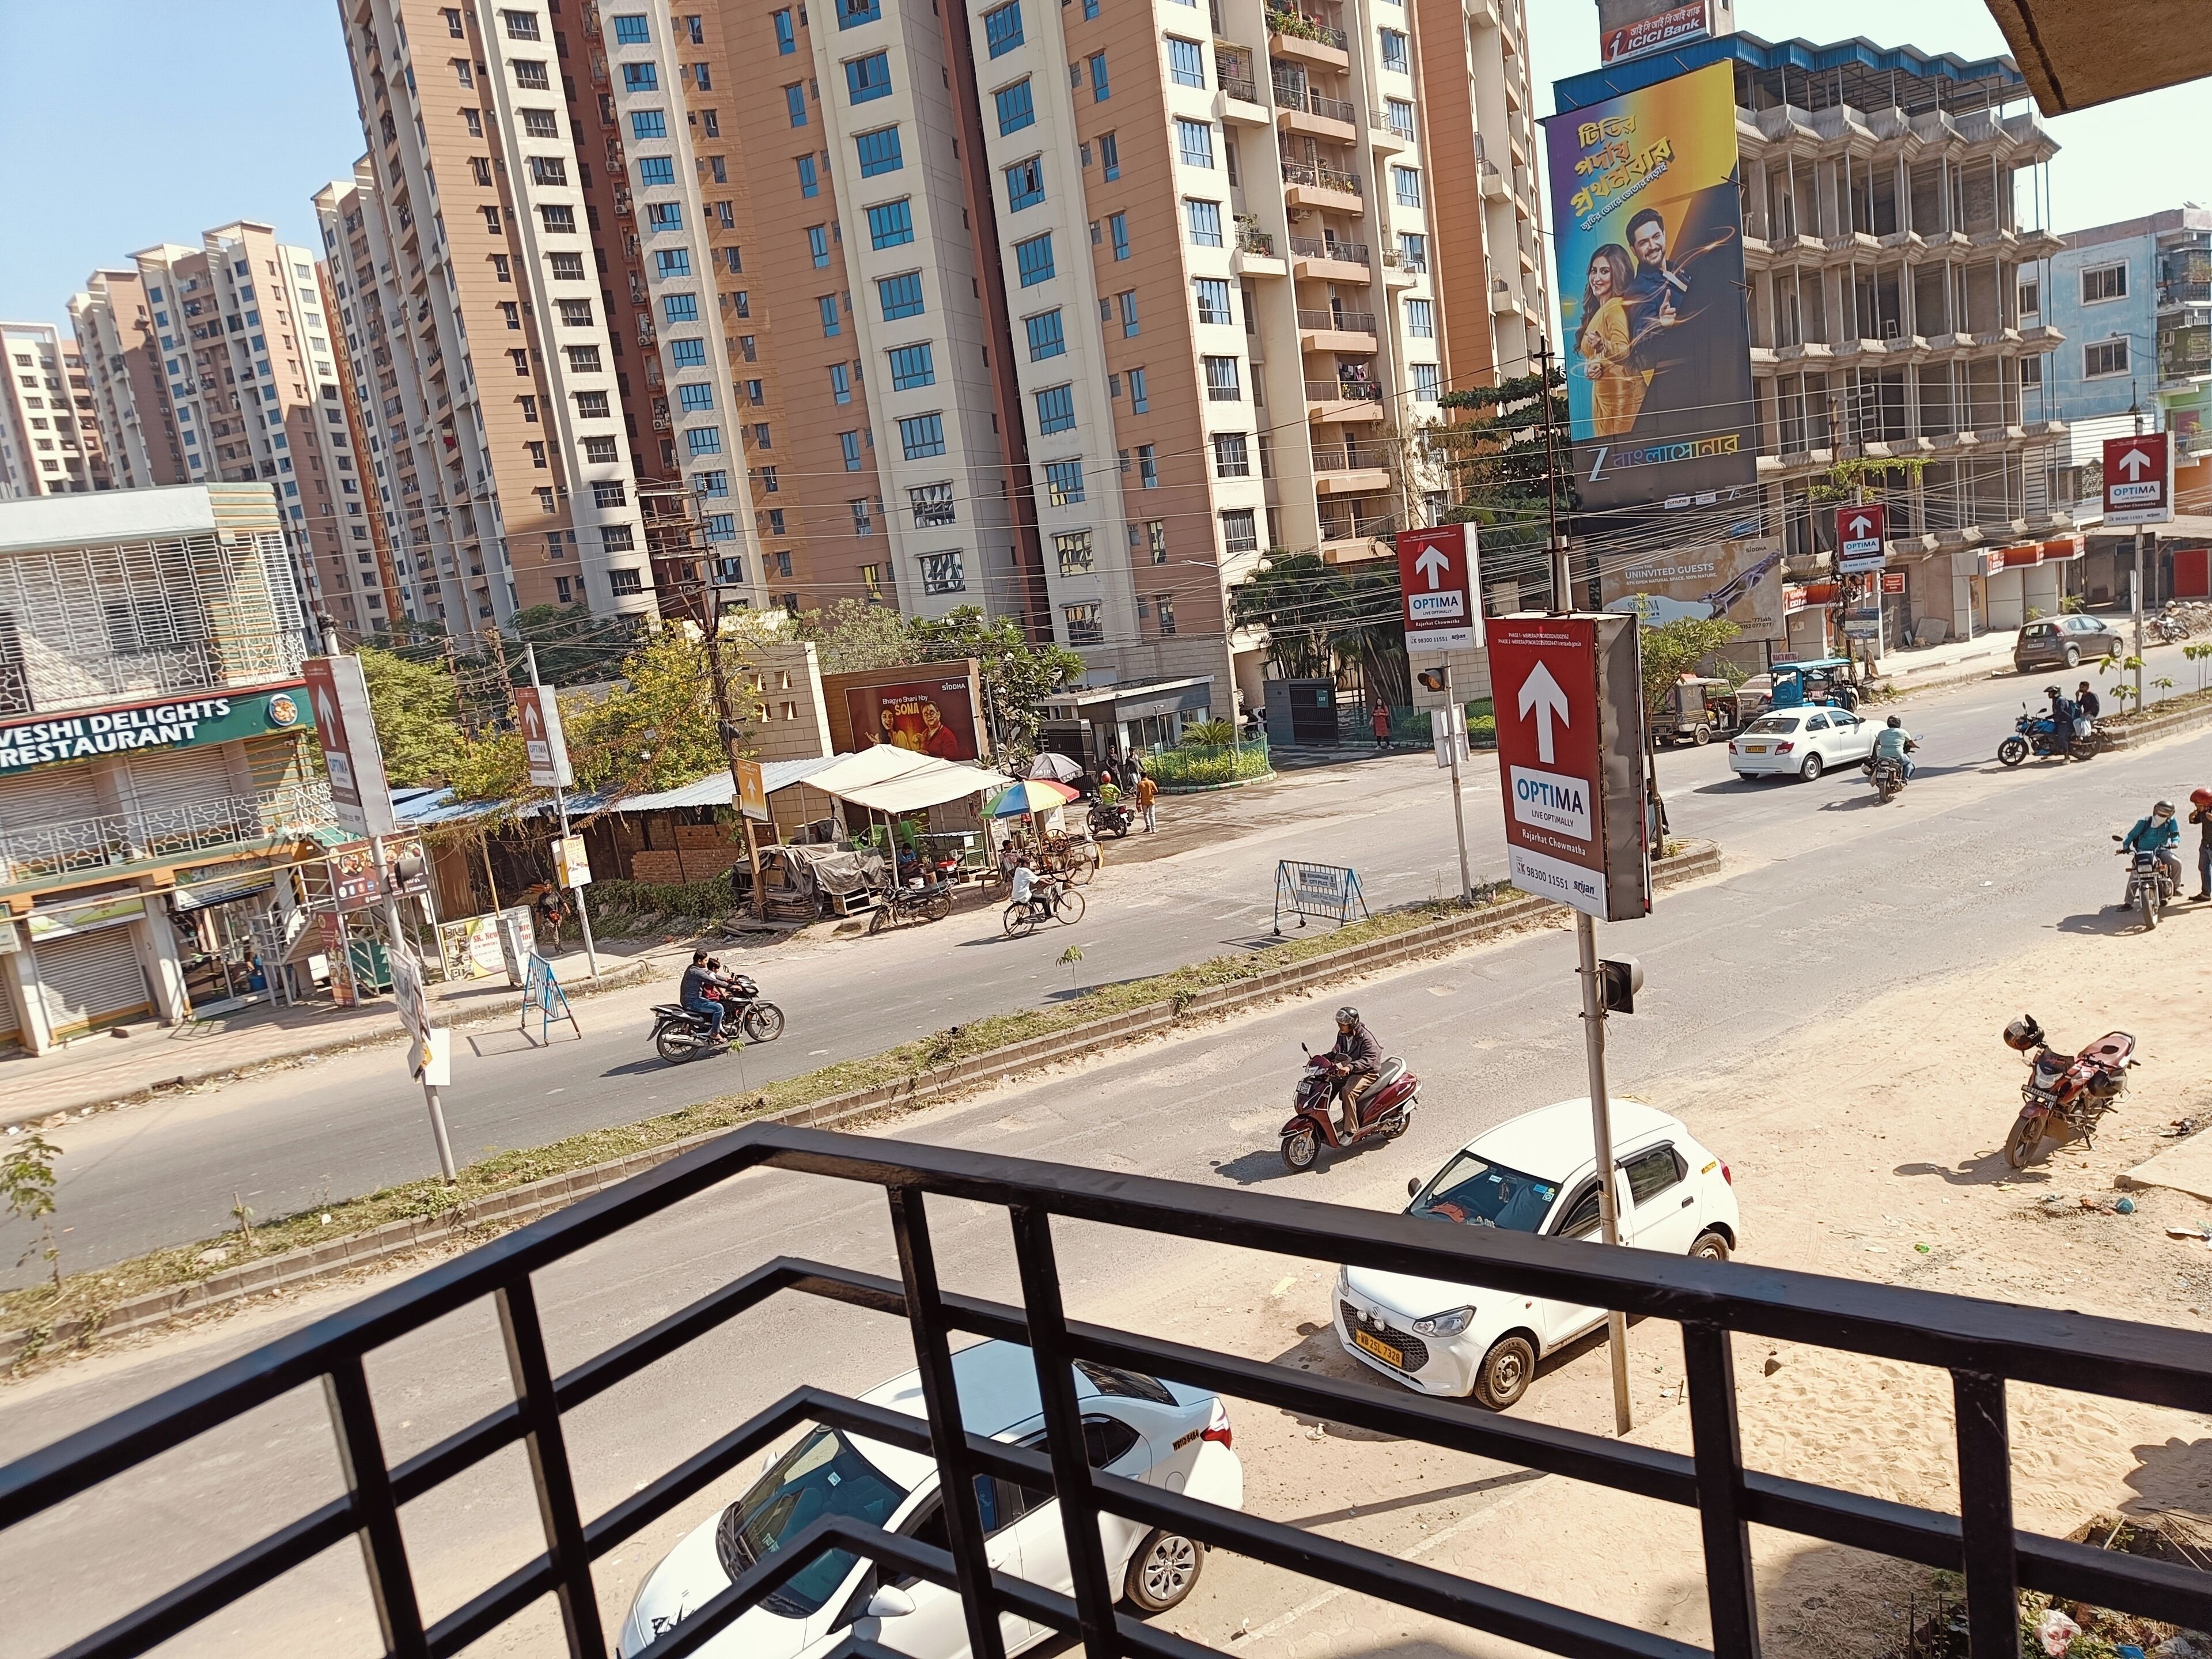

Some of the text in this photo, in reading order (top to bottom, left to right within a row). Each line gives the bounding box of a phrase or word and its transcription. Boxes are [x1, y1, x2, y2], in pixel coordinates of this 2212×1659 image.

[1628, 31, 1661, 50] ICICI
[1664, 18, 1699, 37] Bank
[1631, 24, 1642, 36] আই
[1643, 21, 1651, 32] সি
[1652, 17, 1664, 29] আই
[1665, 14, 1672, 25] সি
[1673, 9, 1685, 21] আই
[2113, 485, 2156, 496] OPTIMA
[1846, 541, 1876, 550] OPTIMA
[1625, 563, 1714, 579] UNINVITED GUESTS
[1413, 596, 1459, 610] OPTIMA
[89, 698, 231, 733] DELIGHTS
[895, 703, 919, 716] SONA
[0, 721, 198, 767] RESTAURANT
[529, 744, 547, 753] OPTIMA
[329, 758, 349, 774] OPTIMA
[1517, 778, 1584, 815] OPTIMA
[1532, 809, 1574, 828] LIVE OPTIMALLY
[1522, 828, 1586, 856] Rajarhat Chowmatha
[1527, 866, 1546, 882] 98300
[1548, 874, 1569, 890] 11551
[1574, 880, 1595, 895] srijan
[1361, 1334, 1400, 1363] WB 25L 7328
